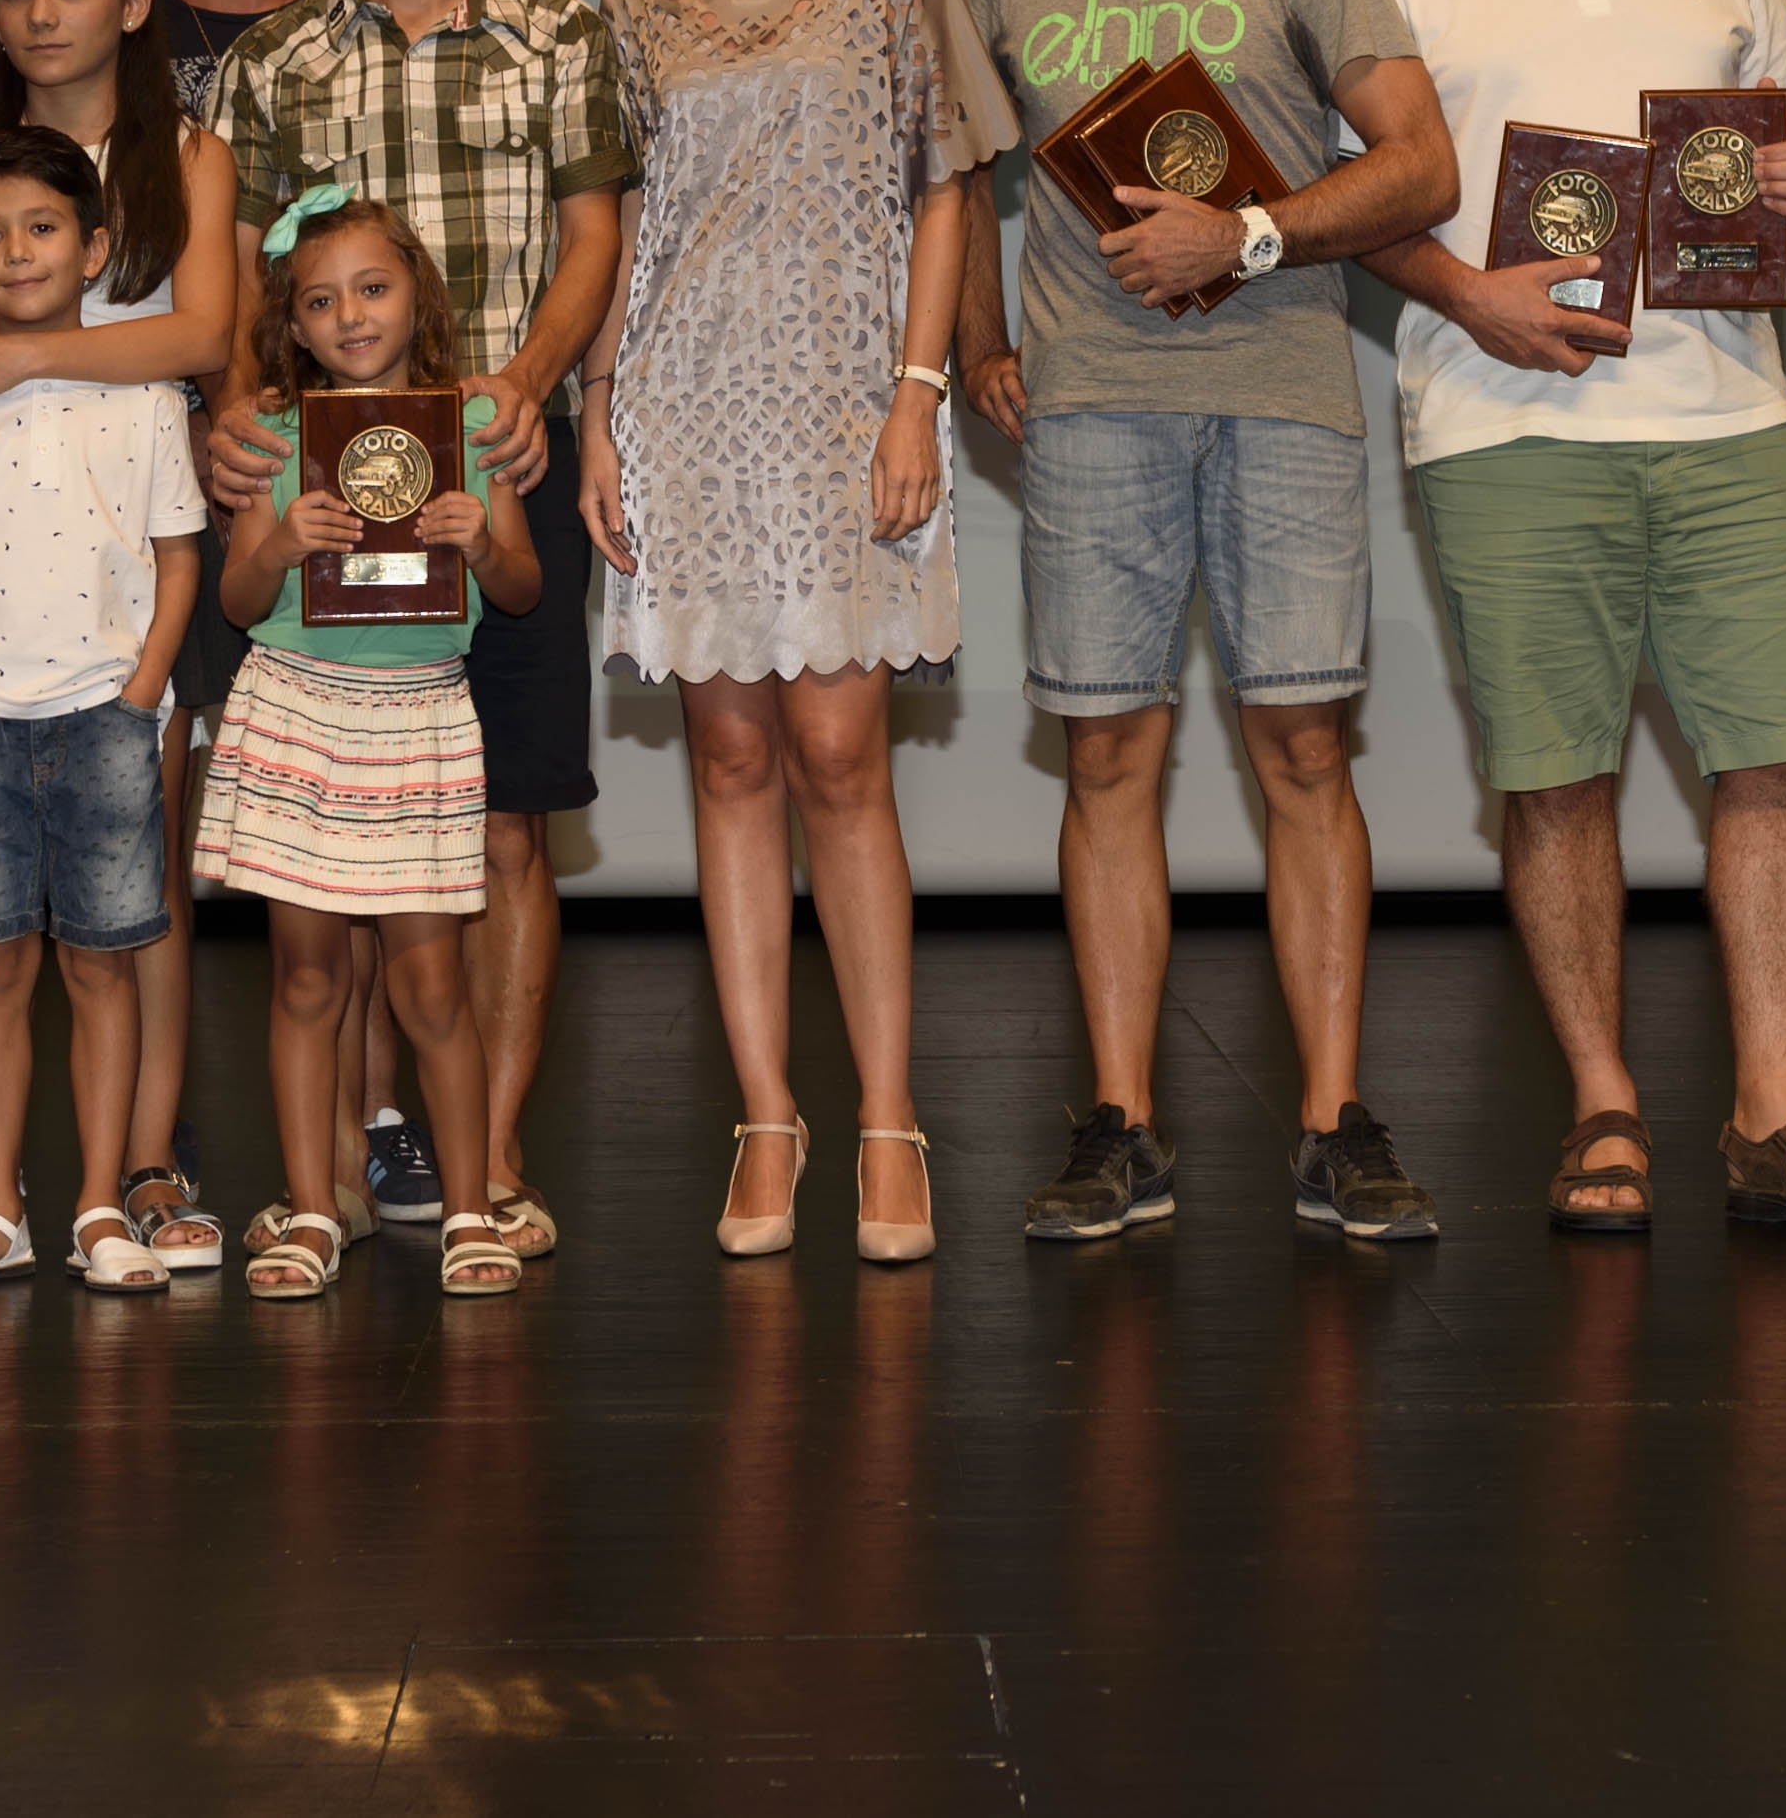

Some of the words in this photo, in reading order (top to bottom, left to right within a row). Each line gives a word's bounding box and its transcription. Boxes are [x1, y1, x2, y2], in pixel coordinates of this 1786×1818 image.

[1692, 132, 1745, 156] FOTO
[1546, 173, 1600, 197] FOTO
[1689, 184, 1745, 211] RALLY
[1542, 225, 1597, 253] RALLY
[352, 431, 409, 460] FOTO
[356, 487, 417, 517] RALLY
